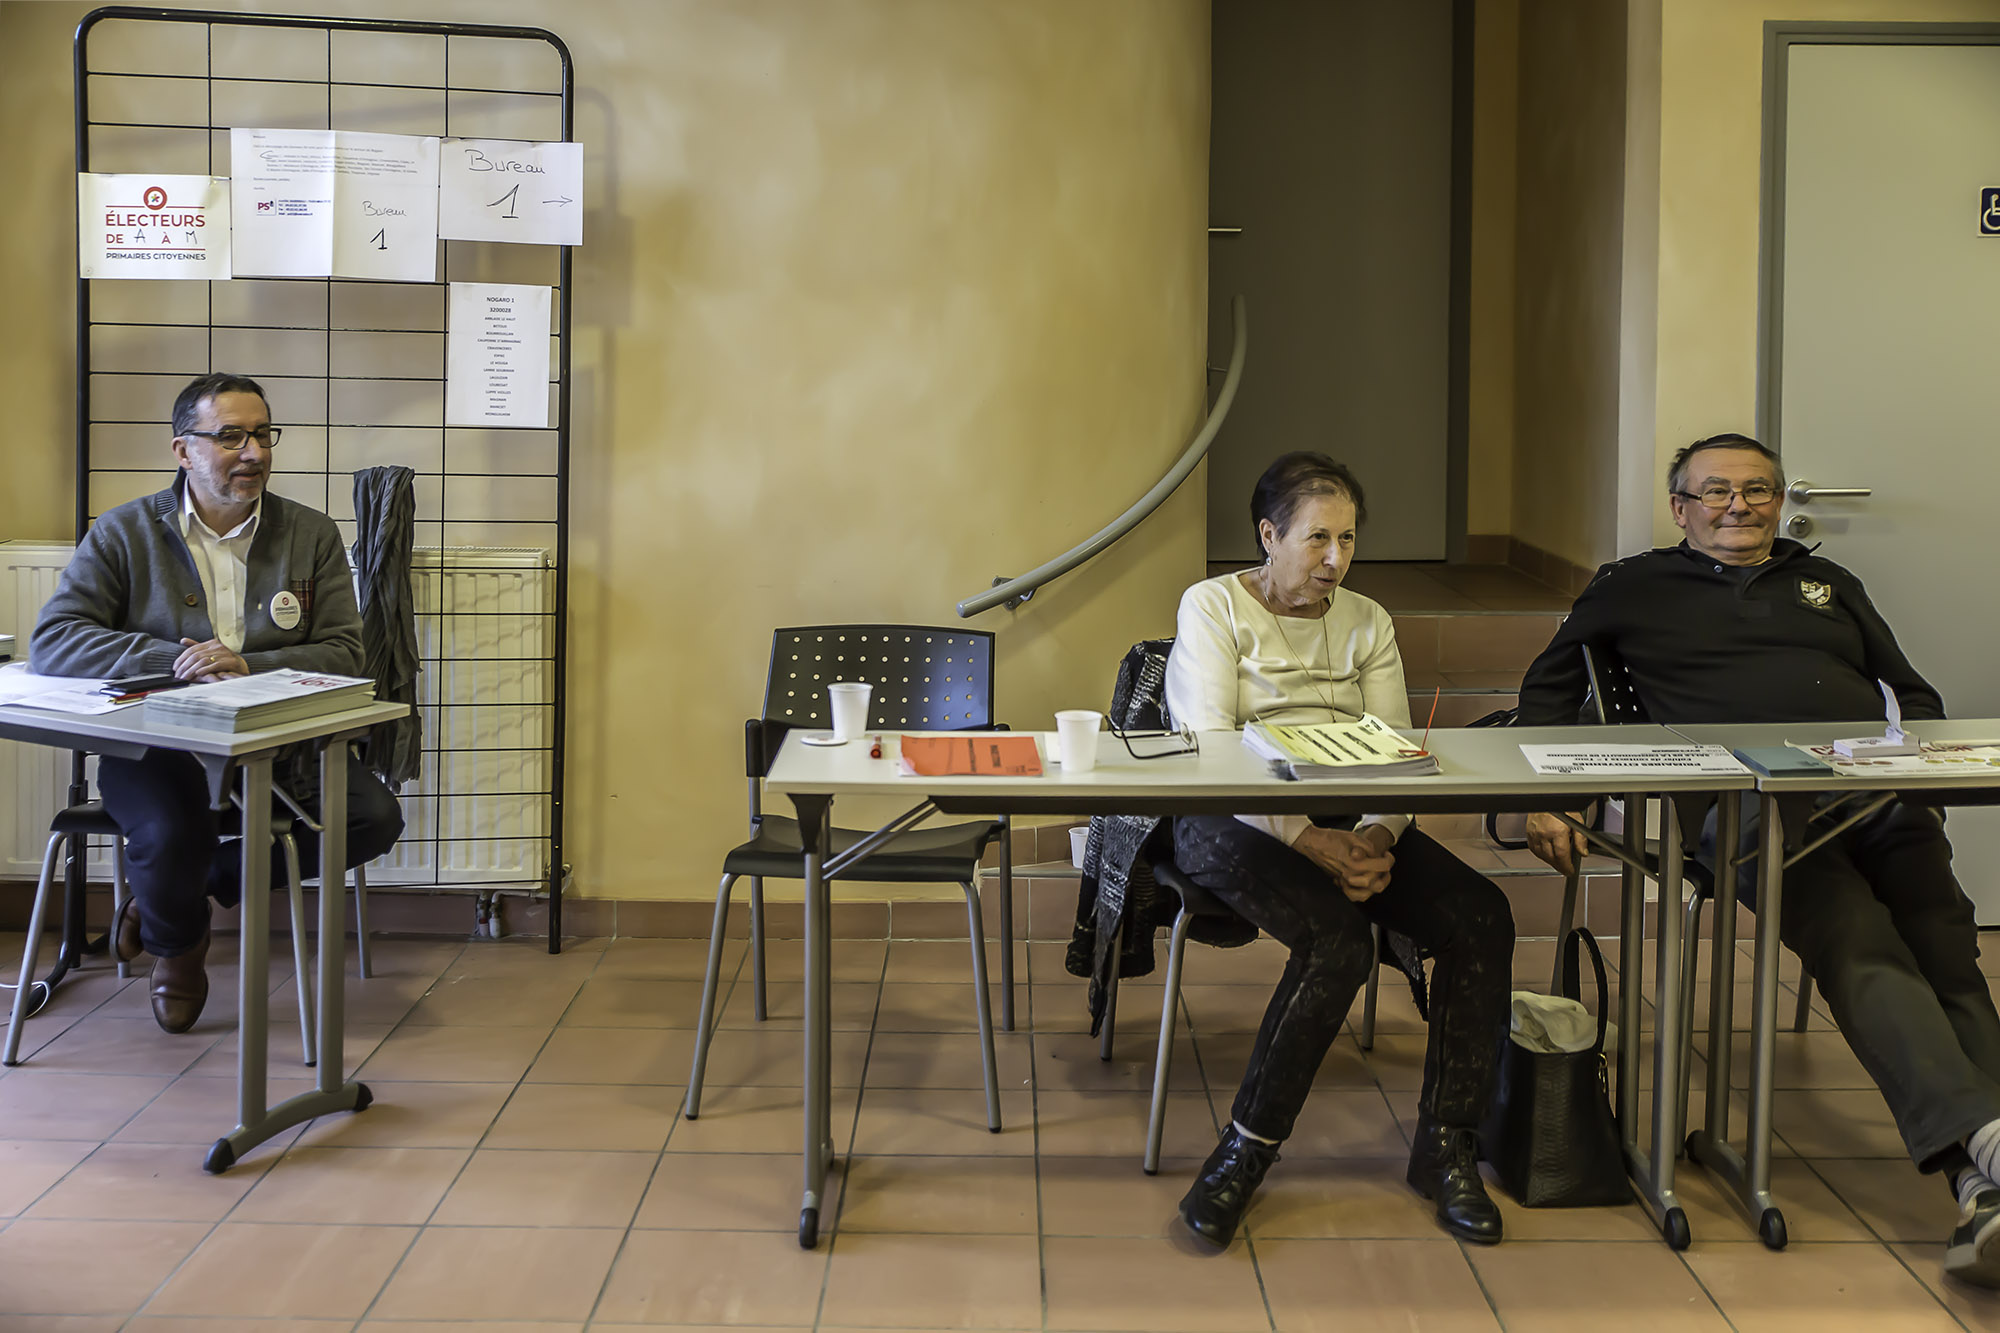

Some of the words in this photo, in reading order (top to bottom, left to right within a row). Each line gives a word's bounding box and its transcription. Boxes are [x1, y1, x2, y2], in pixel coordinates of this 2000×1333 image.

[465, 149, 544, 173] Bureau
[363, 201, 406, 216] Bureau
[487, 184, 519, 218] 1
[106, 210, 205, 227] ÉLECTEURS
[106, 234, 123, 243] DE
[134, 229, 145, 242] A
[162, 232, 170, 244] À
[186, 231, 197, 243] M
[370, 228, 387, 250] 1
[105, 252, 151, 260] PRIMAIRES
[152, 252, 206, 261] CITOYENNES
